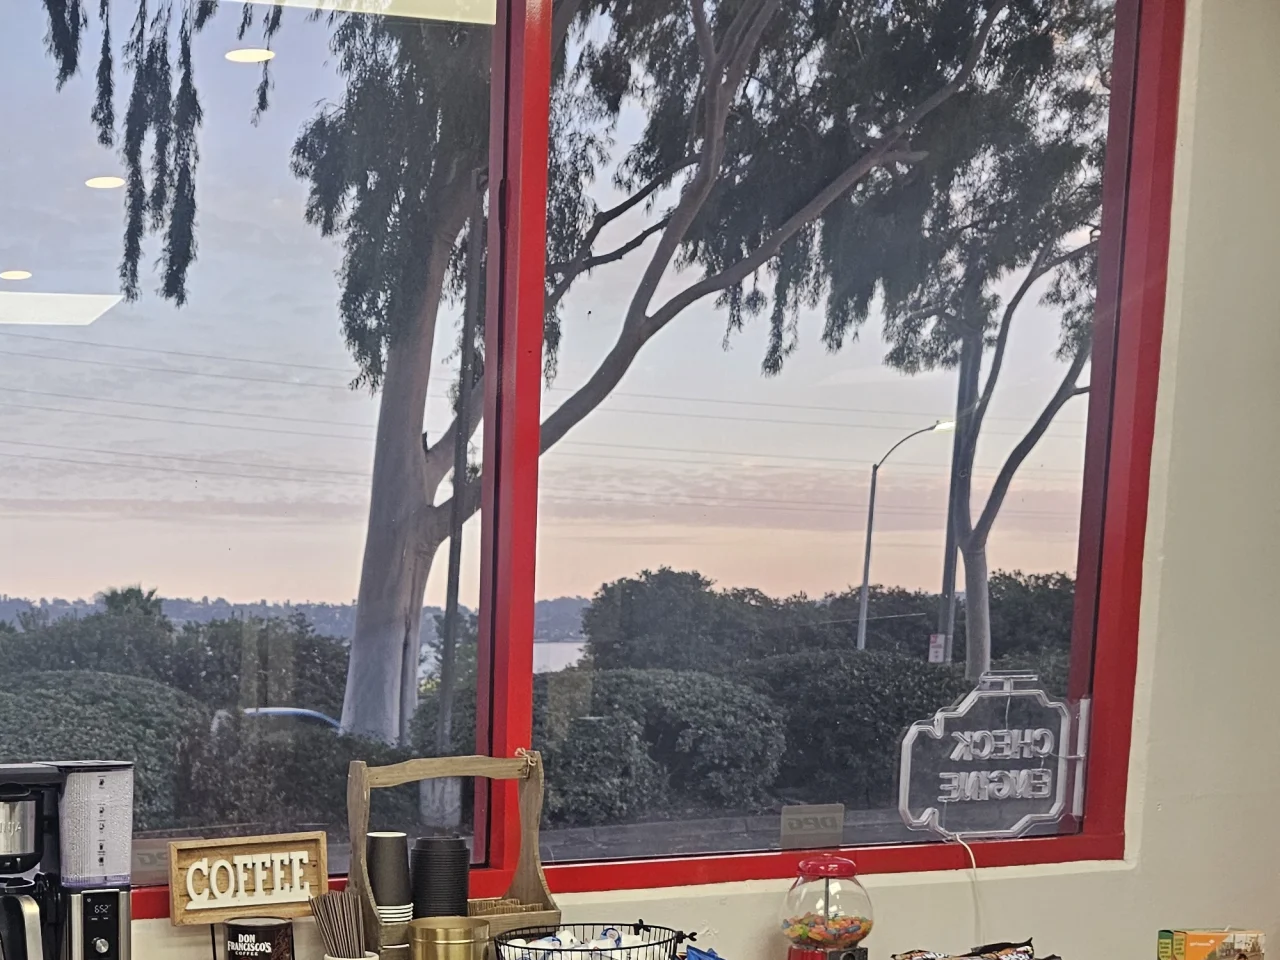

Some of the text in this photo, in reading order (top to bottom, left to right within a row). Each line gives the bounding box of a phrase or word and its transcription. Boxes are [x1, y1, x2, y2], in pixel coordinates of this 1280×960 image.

[186, 851, 310, 902] COFFEE
[238, 934, 256, 942] DON
[228, 940, 272, 953] FRANCISCO'S
